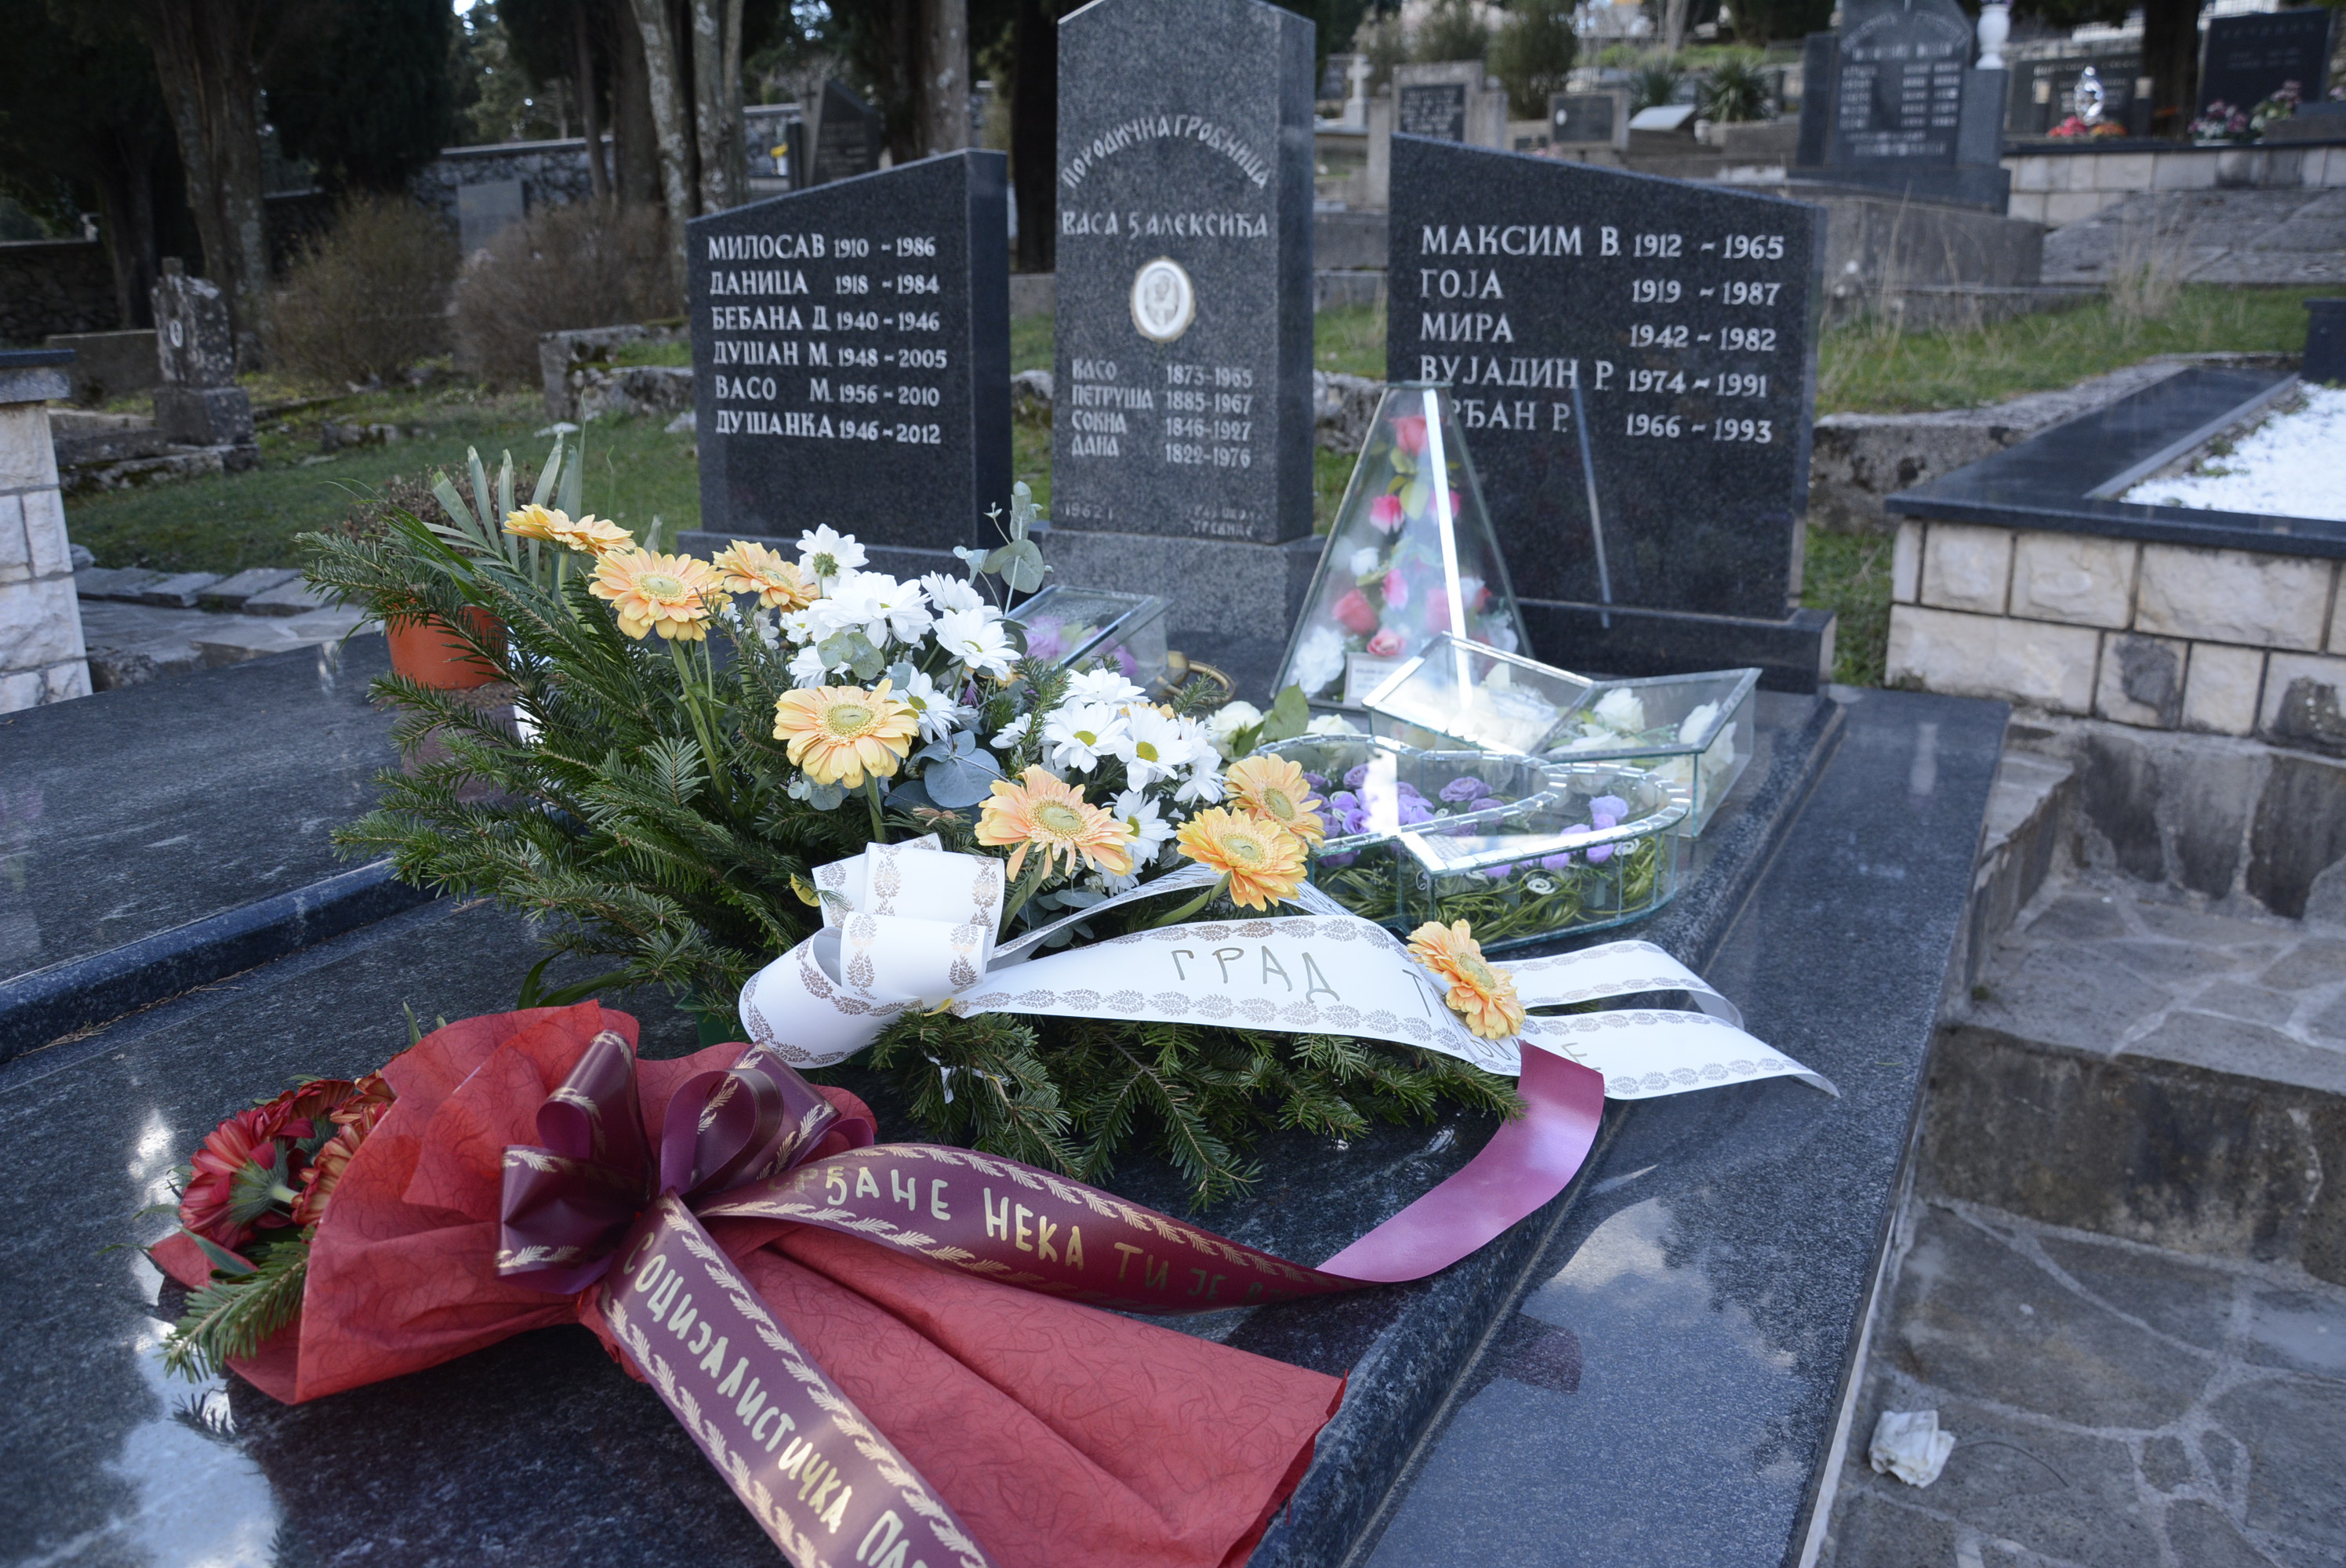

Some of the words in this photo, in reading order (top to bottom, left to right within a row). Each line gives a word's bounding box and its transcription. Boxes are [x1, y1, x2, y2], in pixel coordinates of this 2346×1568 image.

[1062, 211, 1119, 236] ВАСА
[708, 234, 826, 261] МИЛОСАВ
[834, 238, 870, 258] 1910
[896, 237, 936, 257] 1986
[1421, 225, 1583, 256] МАКСИМ
[1633, 234, 1683, 258] 1912
[1723, 234, 1785, 260] 1965
[710, 270, 809, 296] ДАНИЦА
[835, 274, 869, 295] 1918
[896, 274, 940, 295] 1984
[1420, 268, 1504, 299] ГОЈА
[1632, 279, 1682, 303] 1919
[1722, 281, 1781, 306] 1987
[711, 306, 804, 330] БЕБАНА
[837, 311, 878, 331] 1940
[898, 311, 940, 331] 1946
[1420, 313, 1515, 343] МИРА
[1629, 325, 1689, 348] 1942
[1720, 327, 1777, 352] 1982
[713, 340, 799, 365] ДУШАН
[838, 348, 878, 367] 1948
[899, 349, 947, 368] 2005
[715, 374, 777, 401] ВАСО
[839, 384, 878, 404] 1956
[898, 386, 939, 407] 2010
[1420, 355, 1580, 387] ВУЈАДИН
[1629, 369, 1686, 394] 1974
[1716, 373, 1767, 398] 1991
[1072, 384, 1154, 409] ПЕТРУША
[715, 409, 835, 438] ДУШАНКА
[839, 420, 879, 441] 1946
[896, 423, 941, 445] 2012
[1626, 413, 1681, 438] 1966
[1712, 417, 1773, 444] 1993
[1171, 946, 1341, 1004] ГРАД
[983, 1186, 1084, 1271] НЕКА
[1113, 1241, 1169, 1292] ТИ
